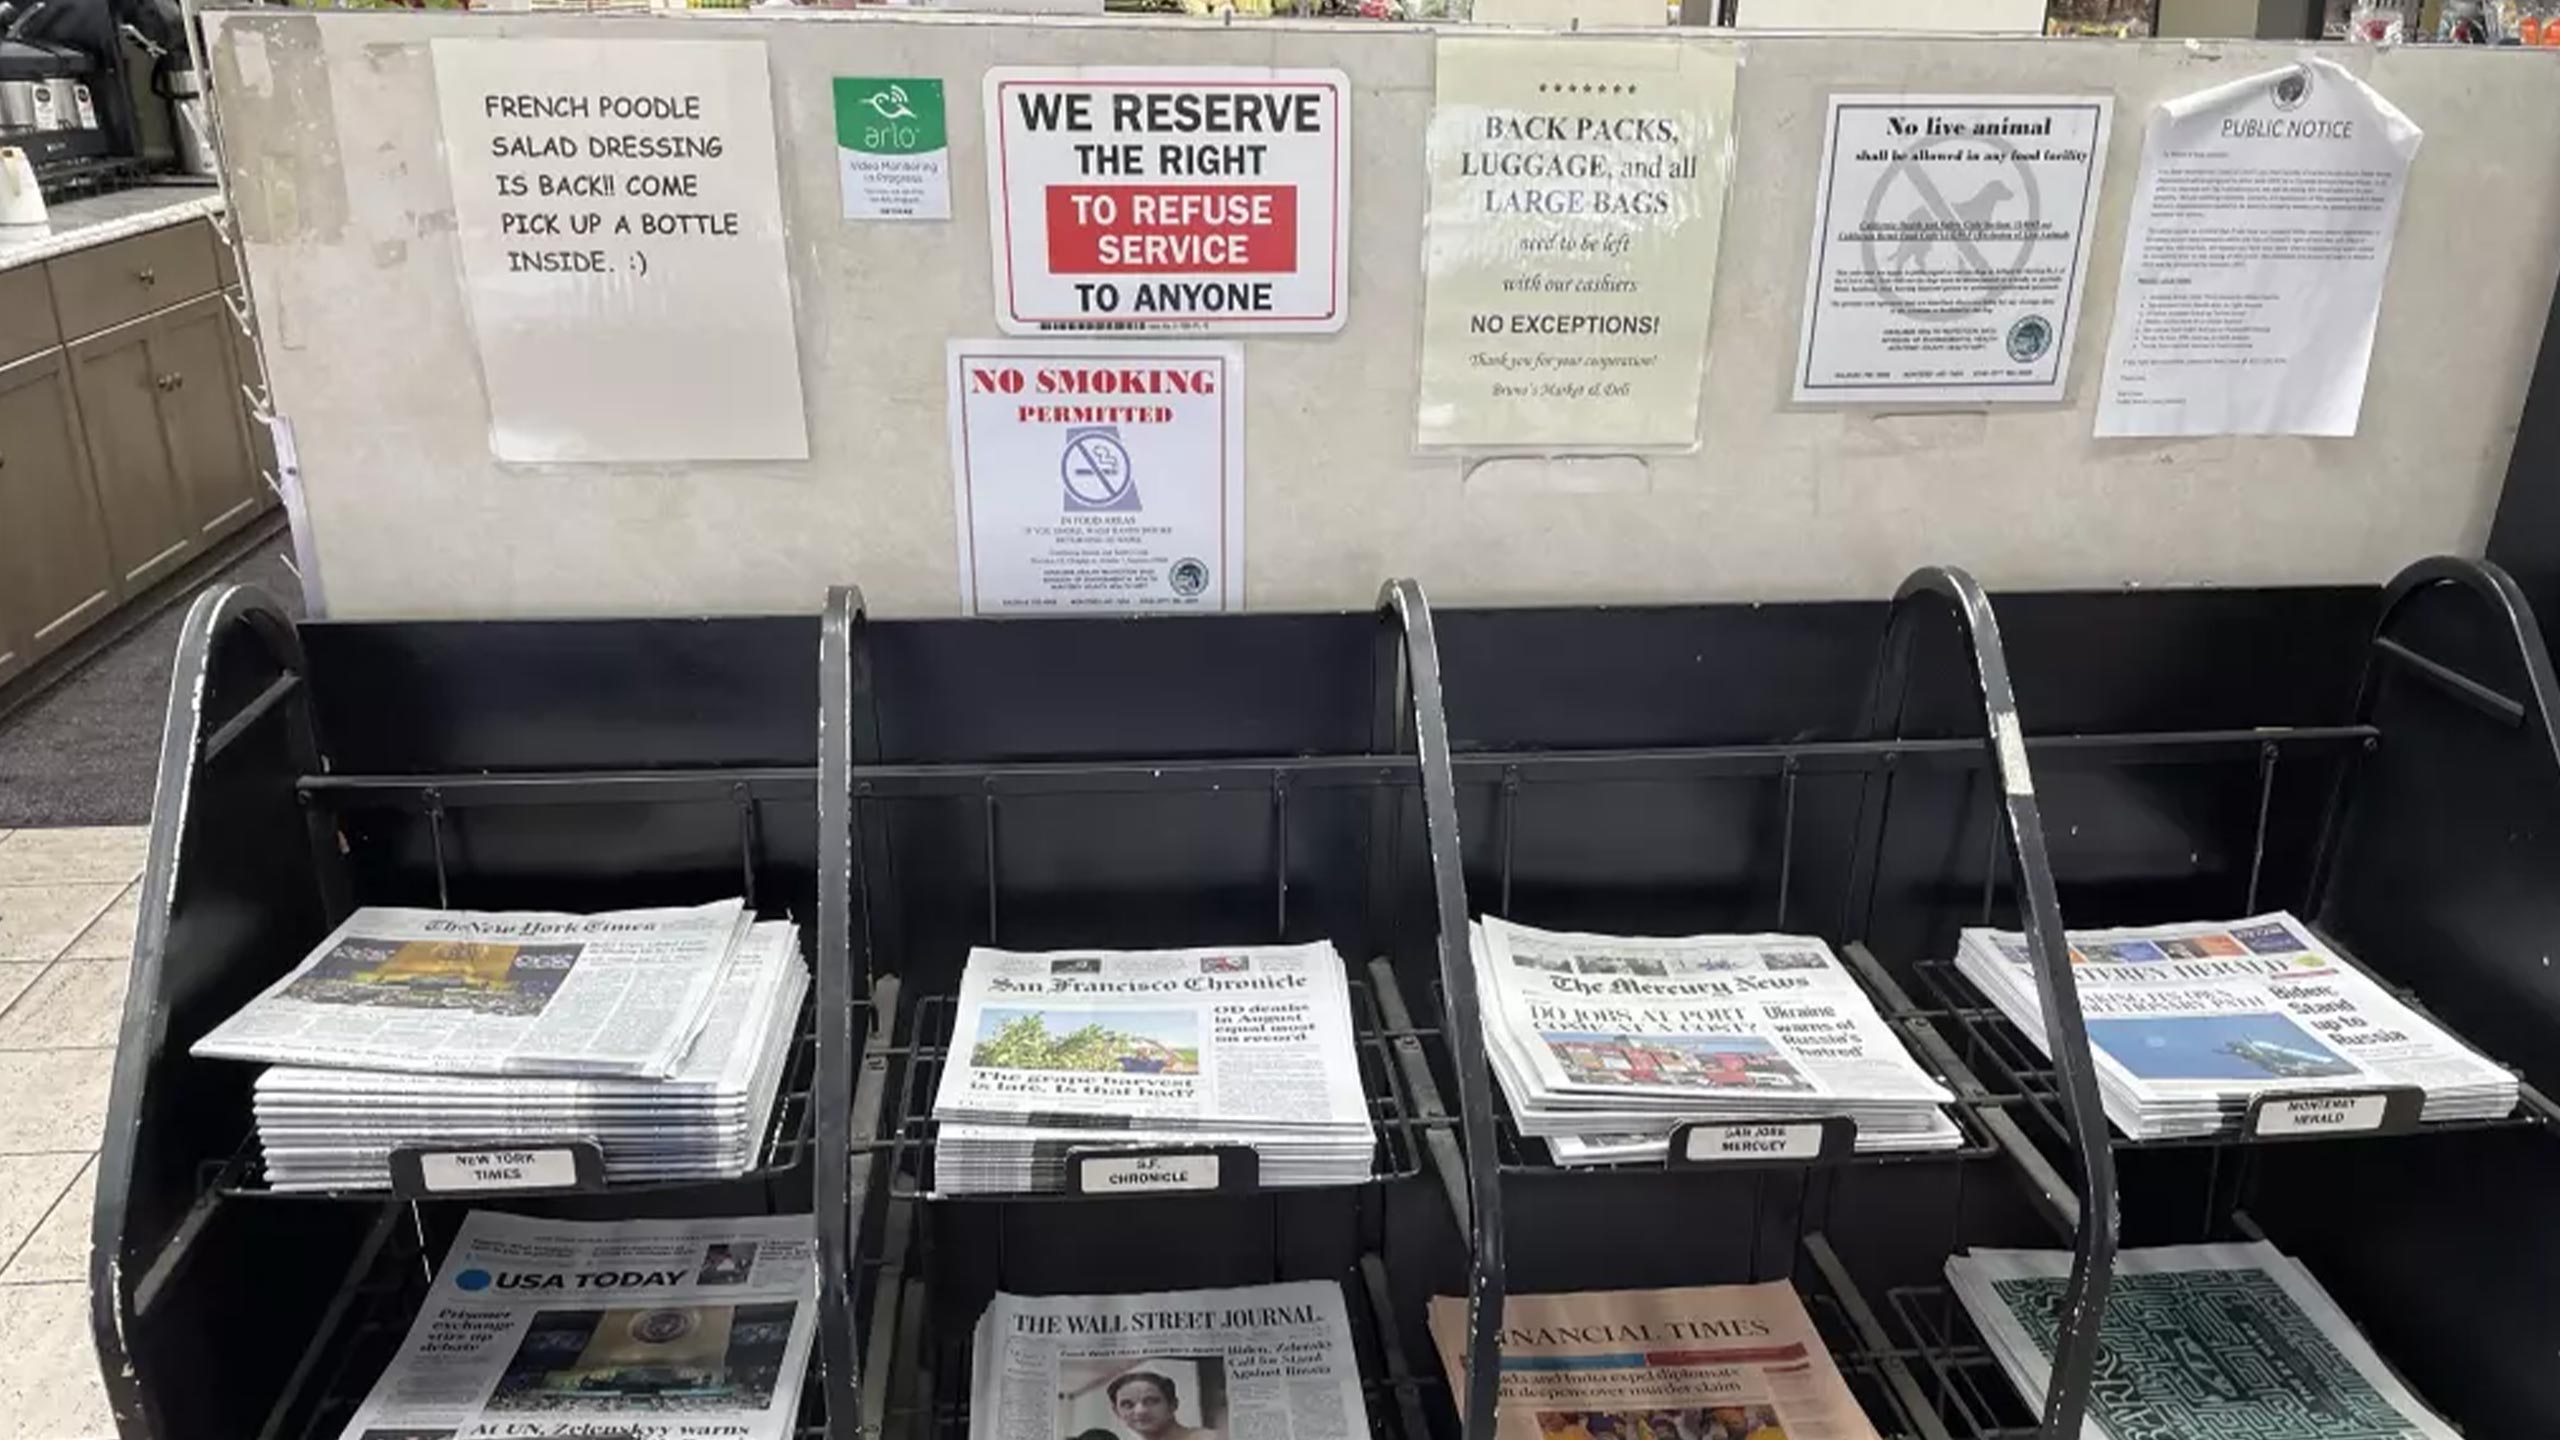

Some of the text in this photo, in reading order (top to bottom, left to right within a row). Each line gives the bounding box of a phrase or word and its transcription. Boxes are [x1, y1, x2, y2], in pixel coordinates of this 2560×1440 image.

[484, 95, 701, 119] FRENCH POODLE
[1017, 93, 1321, 133] WE RESERVE
[864, 121, 916, 149] arlo
[1485, 115, 1680, 145] BACK PACKS,
[1886, 115, 2053, 137] No live animal
[2220, 118, 2354, 140] PUBLIC NOTICE
[491, 135, 723, 159] SALAD DRESSING
[1855, 148, 2089, 164] shall be allowed in any food facility
[850, 161, 940, 175] Video Monitoring
[1074, 144, 1267, 176] THE RIGHT
[1461, 152, 1698, 180] LUGGAGE, and all
[496, 173, 699, 198] IS BACK!! COME
[876, 173, 924, 186] Progress
[1070, 194, 1273, 226] TO REFUSE
[1485, 189, 1670, 214] LARGE BAGS
[501, 213, 740, 237] PICK UP A BOTTLE
[1098, 235, 1249, 265] SERVICE
[1519, 232, 1631, 257] need to be left
[508, 250, 615, 274] INSIDE.
[1502, 273, 1640, 293] with our cashiers
[1074, 283, 1273, 312] TO ANYONE
[1470, 314, 1661, 335] NO EXCEPTIONS!
[1469, 352, 1658, 371] Thank you for your cooperation!
[972, 368, 1216, 396] NO SMOKING
[1491, 382, 1539, 397] Bruno's
[1539, 382, 1585, 398] Market
[1602, 382, 1631, 396] Deli
[1016, 405, 1174, 424] PERMITTED
[424, 920, 657, 937] The New York Times
[2173, 960, 2289, 979] HERALD
[987, 973, 1309, 995] San Francisco Chronicle
[1549, 974, 1811, 998] The Mercury News
[1248, 1003, 1310, 1013] deaths
[1530, 1004, 1747, 1023] DO JOBS AT PORT
[1762, 1005, 1837, 1020] Ukraine
[2287, 998, 2358, 1015] Stand
[1214, 1013, 1302, 1025] in August
[1774, 1019, 1857, 1033] warns of
[2310, 1015, 2369, 1032] up to
[1214, 1023, 1316, 1035] equal most
[1243, 1033, 1307, 1043] record
[2327, 1029, 2409, 1045] Russia
[1781, 1032, 1863, 1046] Russia's
[972, 1070, 1195, 1087] The grape harvest
[970, 1081, 991, 1091] is
[1083, 1085, 1132, 1096] that
[1137, 1086, 1197, 1099] bad?
[2287, 1099, 2357, 1112] MONTEREY
[2293, 1113, 2345, 1125] HERALD
[1725, 1127, 1788, 1139] SAN JOSE
[455, 1153, 536, 1166] NEW YORK
[474, 1168, 522, 1181] TIMES
[1108, 1170, 1189, 1185] CHRONICLE
[496, 1269, 690, 1289] USA TODAY
[439, 1308, 511, 1319] Prisoner
[1012, 1312, 1063, 1335] THE
[1066, 1312, 1128, 1335] WALL
[1131, 1309, 1217, 1331] STREET
[431, 1321, 516, 1331] exchange
[1498, 1318, 1771, 1346] INANCIAL TIMES
[427, 1333, 494, 1342] stirs up
[419, 1342, 480, 1352] debate
[1228, 1352, 1324, 1368] Call for Stand
[1230, 1365, 1332, 1381] Against Russia
[1532, 1371, 1562, 1384] and
[1563, 1369, 1608, 1384] India
[1610, 1370, 1652, 1385] expel
[1518, 1380, 1742, 1400] deepens over murder claim
[470, 1422, 751, 1438] At UN, Zelenskyy warns
